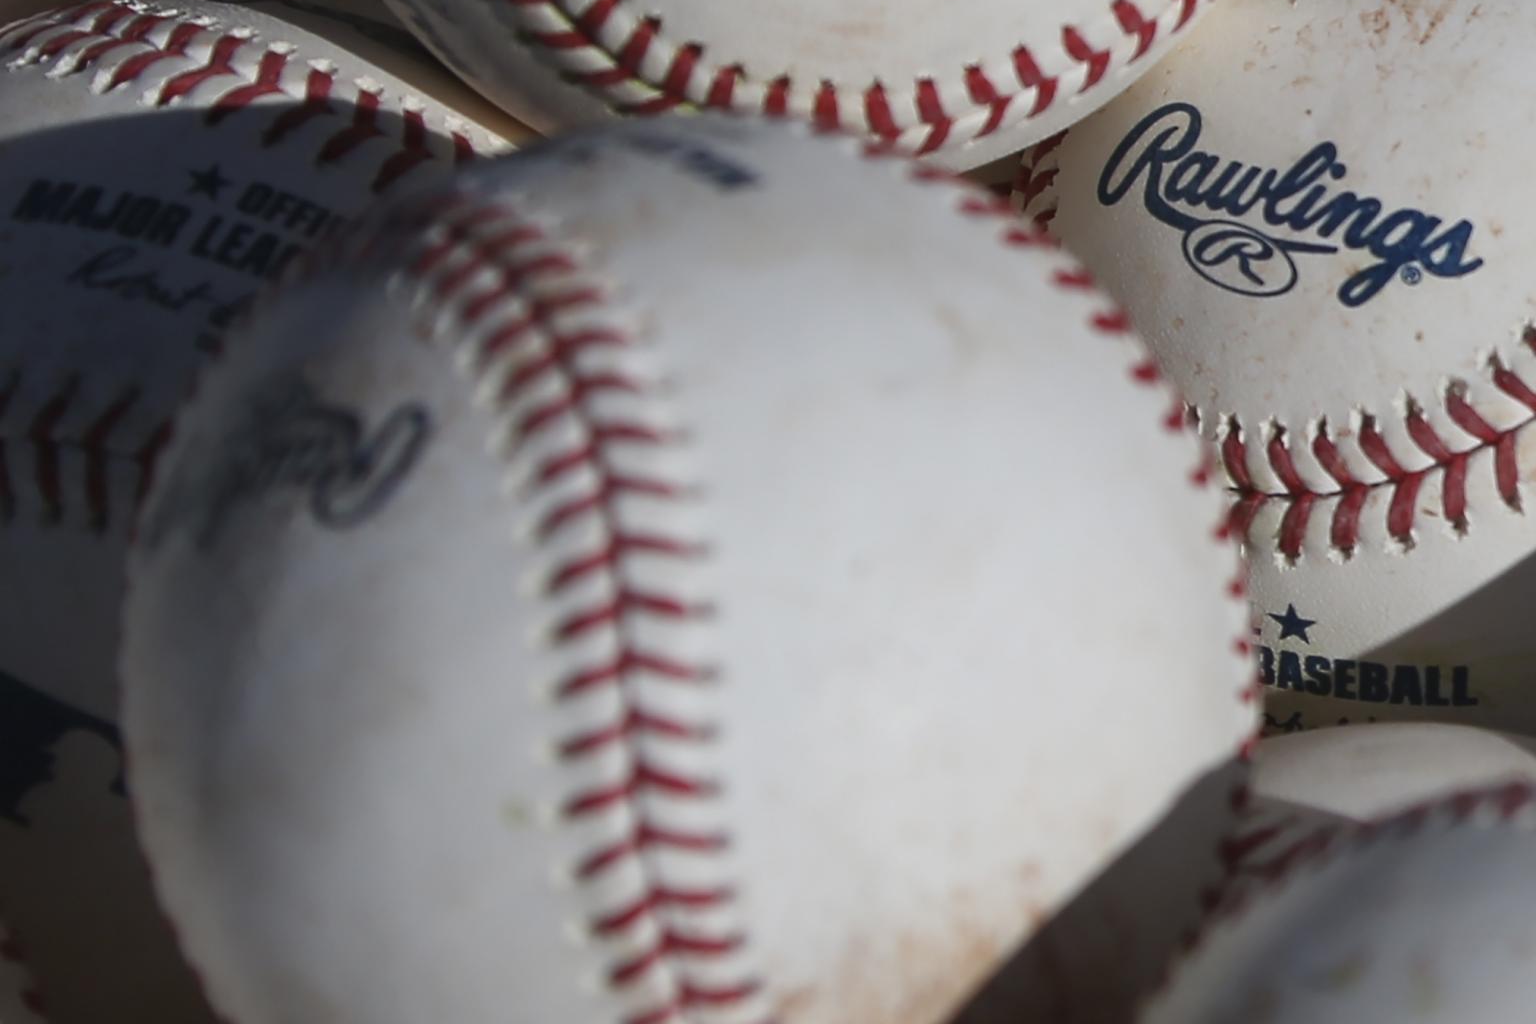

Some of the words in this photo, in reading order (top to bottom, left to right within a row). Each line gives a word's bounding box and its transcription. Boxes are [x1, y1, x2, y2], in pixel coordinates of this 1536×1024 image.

[12, 179, 193, 249] MAJOR
[236, 182, 350, 238] OFFI
[1097, 102, 1484, 307] Rawlings
